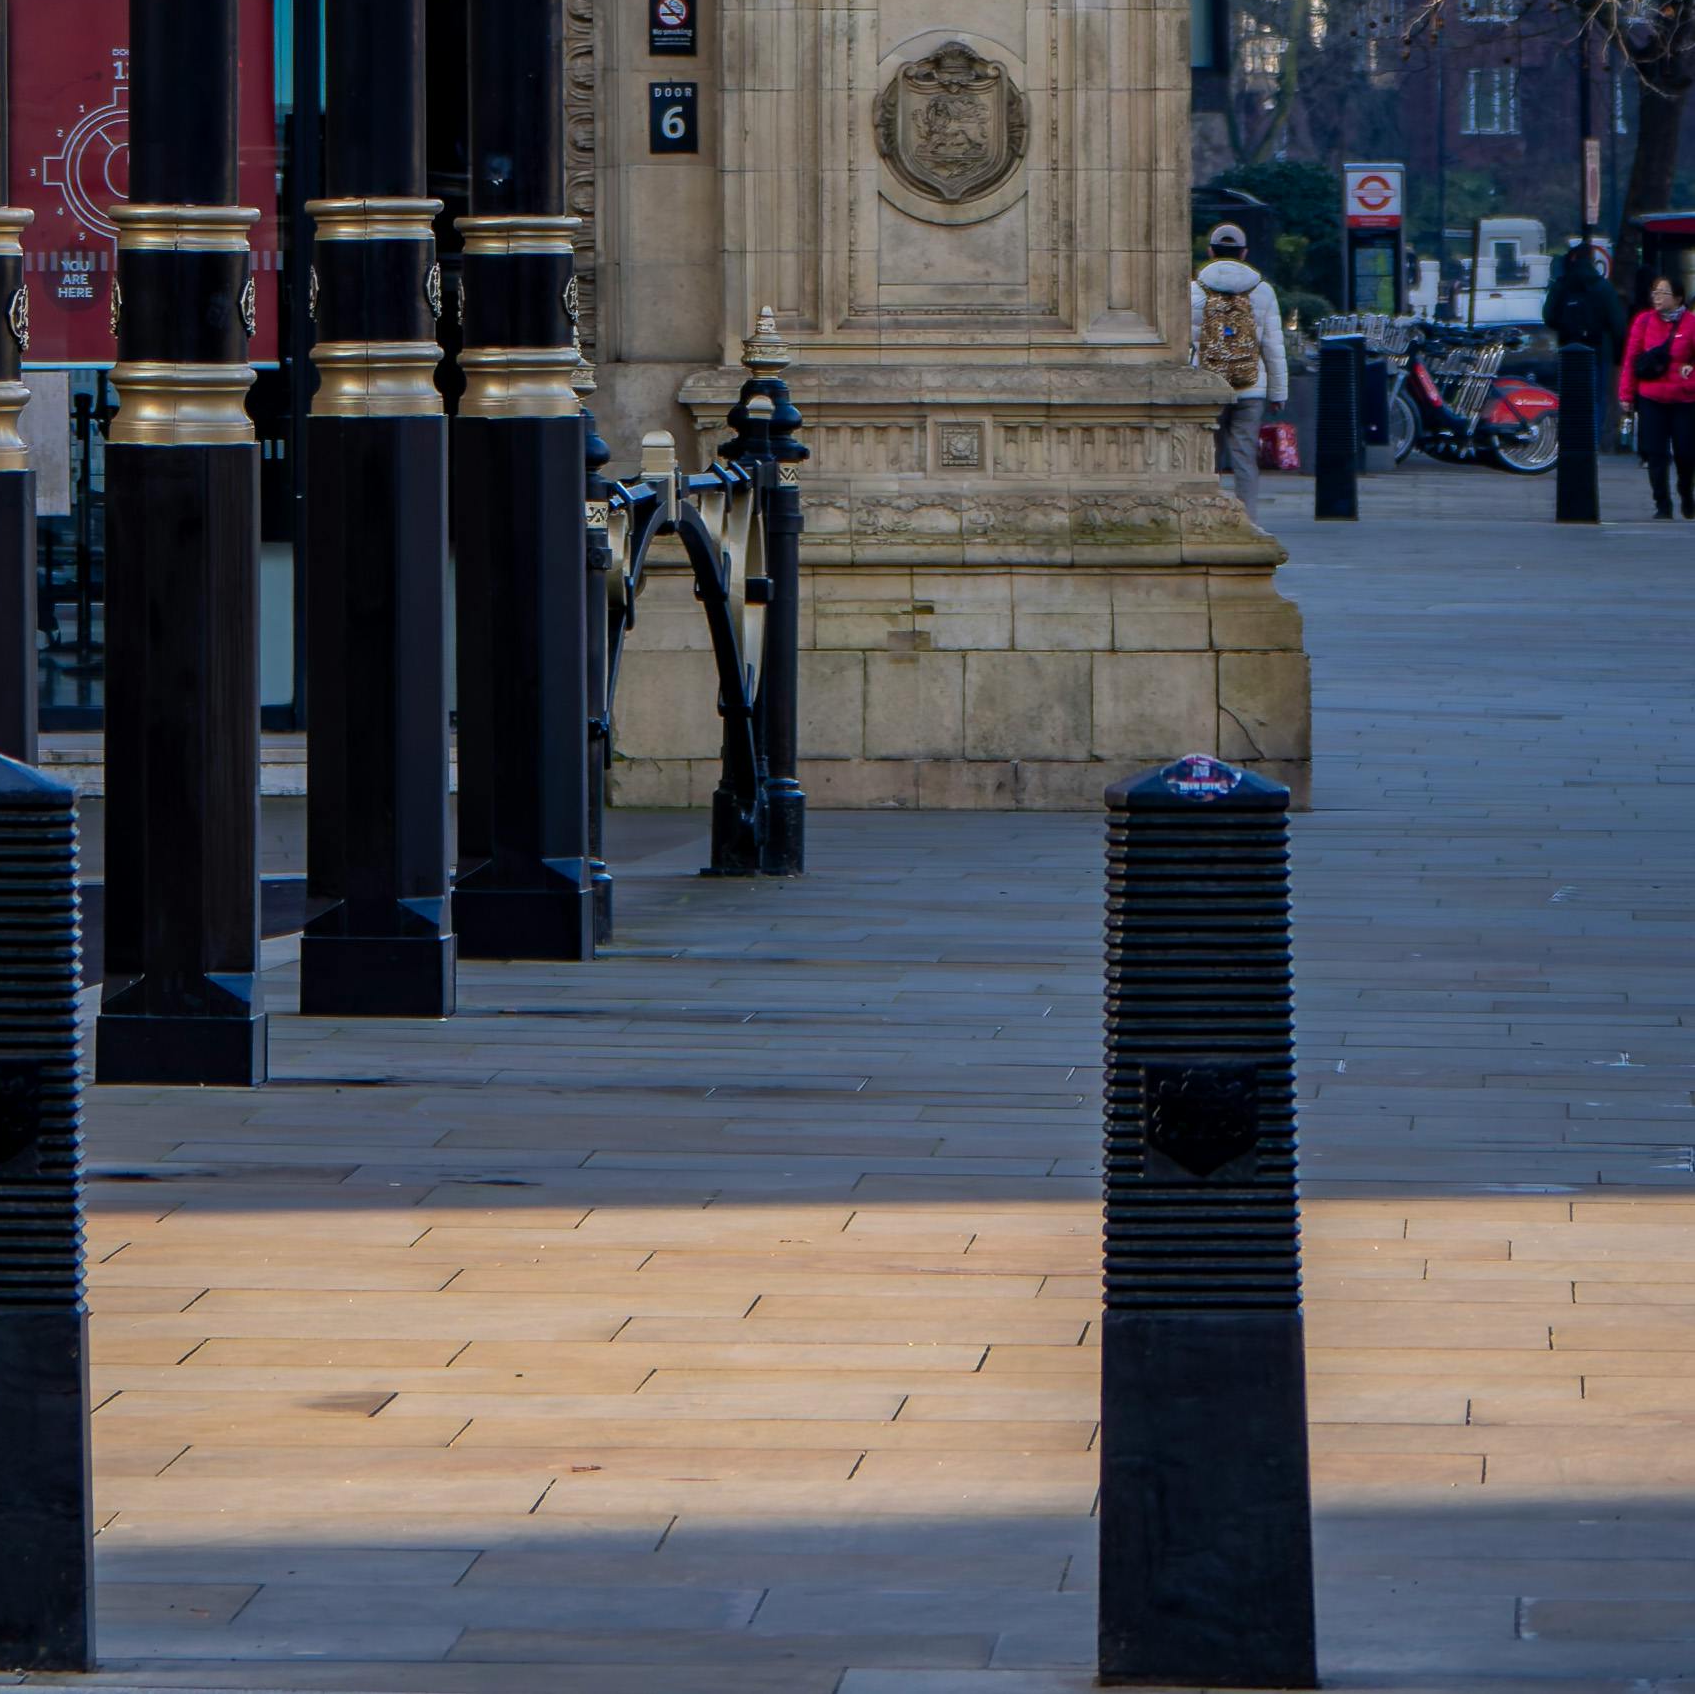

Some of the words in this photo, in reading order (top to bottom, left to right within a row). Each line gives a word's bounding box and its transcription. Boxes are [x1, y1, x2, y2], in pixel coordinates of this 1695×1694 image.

[655, 88, 693, 98] DOOR
[662, 106, 685, 139] 6
[62, 260, 89, 271] YOU
[62, 274, 88, 285] ARE
[58, 288, 93, 298] HERE
